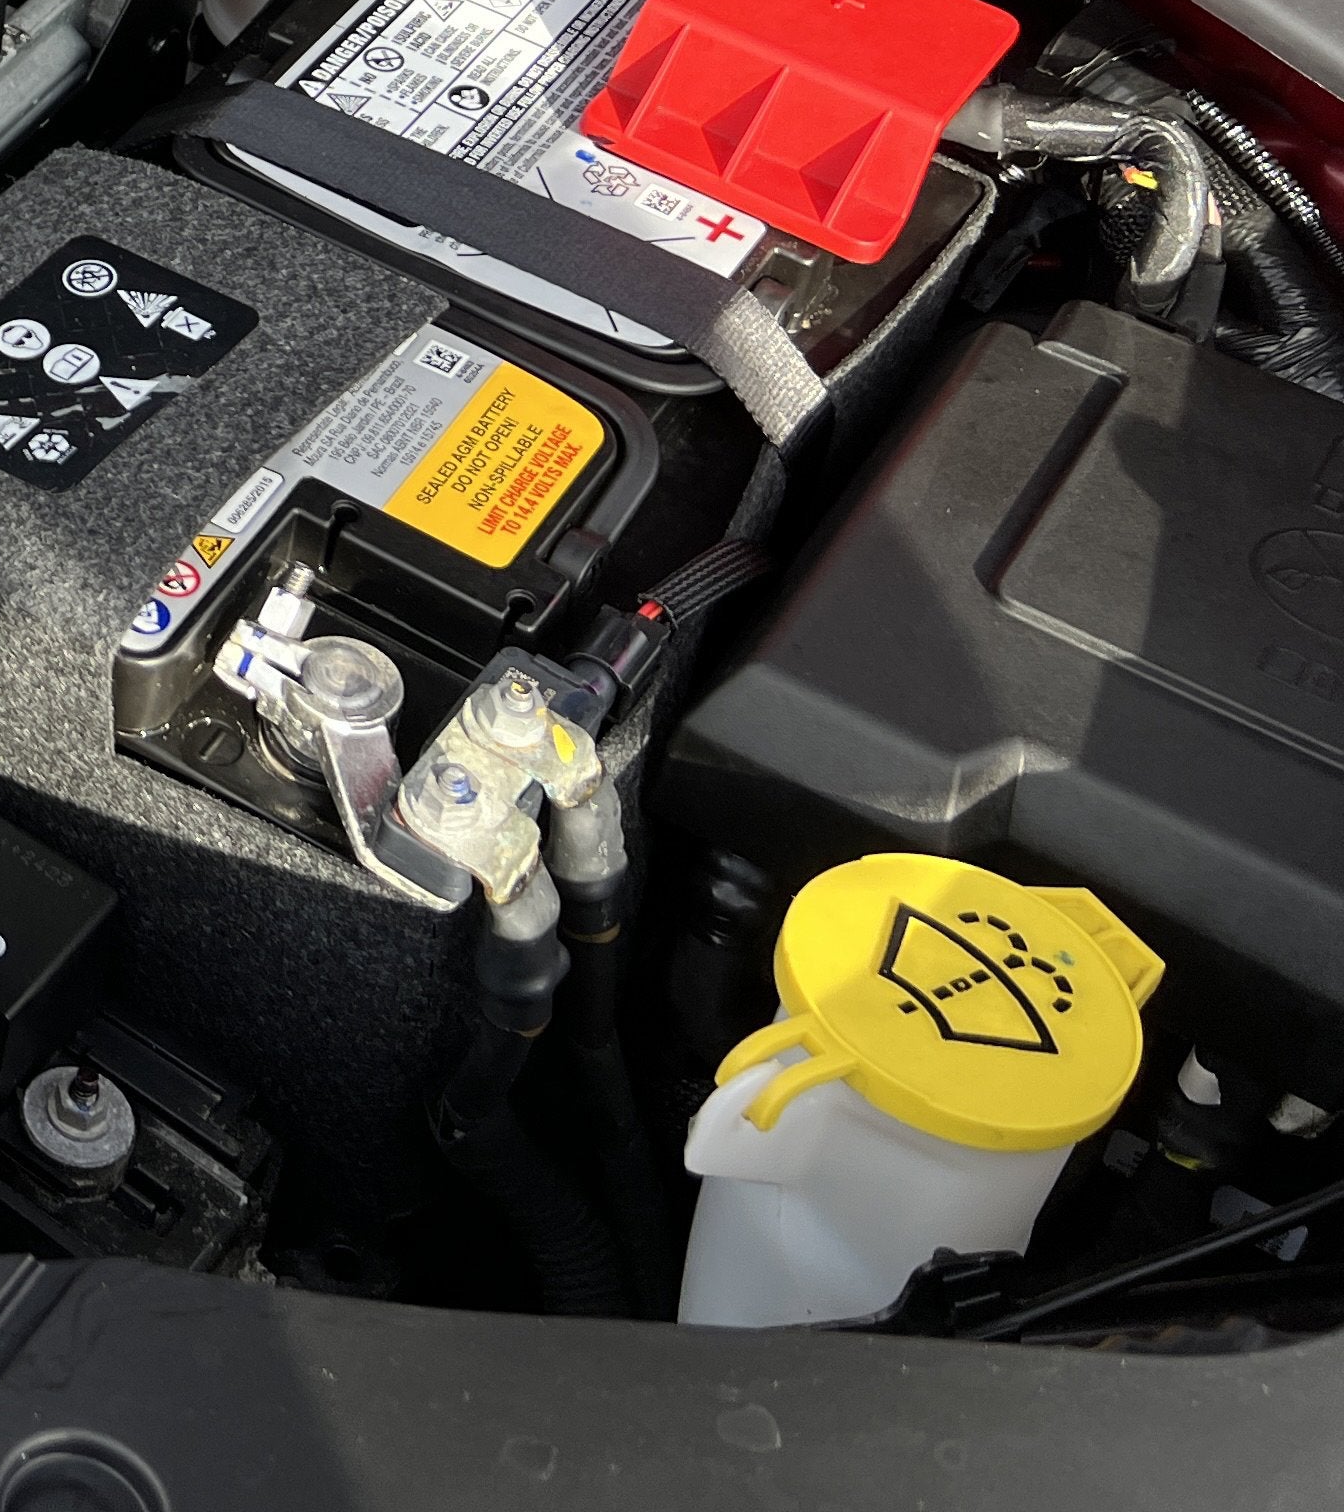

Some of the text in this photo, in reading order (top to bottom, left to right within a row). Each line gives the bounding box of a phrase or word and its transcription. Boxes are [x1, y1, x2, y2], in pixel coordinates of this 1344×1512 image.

[408, 31, 433, 49] ACID
[422, 41, 442, 55] CAN
[357, 71, 378, 84] NO
[397, 72, 429, 97] FLAMES
[411, 75, 444, 103] SMOKING
[409, 126, 428, 139] THE
[370, 397, 386, 410] PE
[319, 434, 336, 447] SA
[355, 395, 369, 406] de
[365, 441, 387, 460] SAC
[414, 459, 460, 505] SEALED
[448, 434, 479, 463] AGM
[469, 386, 518, 437] BATTERY
[450, 415, 520, 493] DO NOT OPEN!
[370, 449, 398, 477] Normas
[465, 423, 544, 511] NON-SPILLABLE
[475, 423, 573, 535] LIMIT CHARGE VOLTAGE
[499, 439, 584, 536] TO 14.4 VOLTS MAX.
